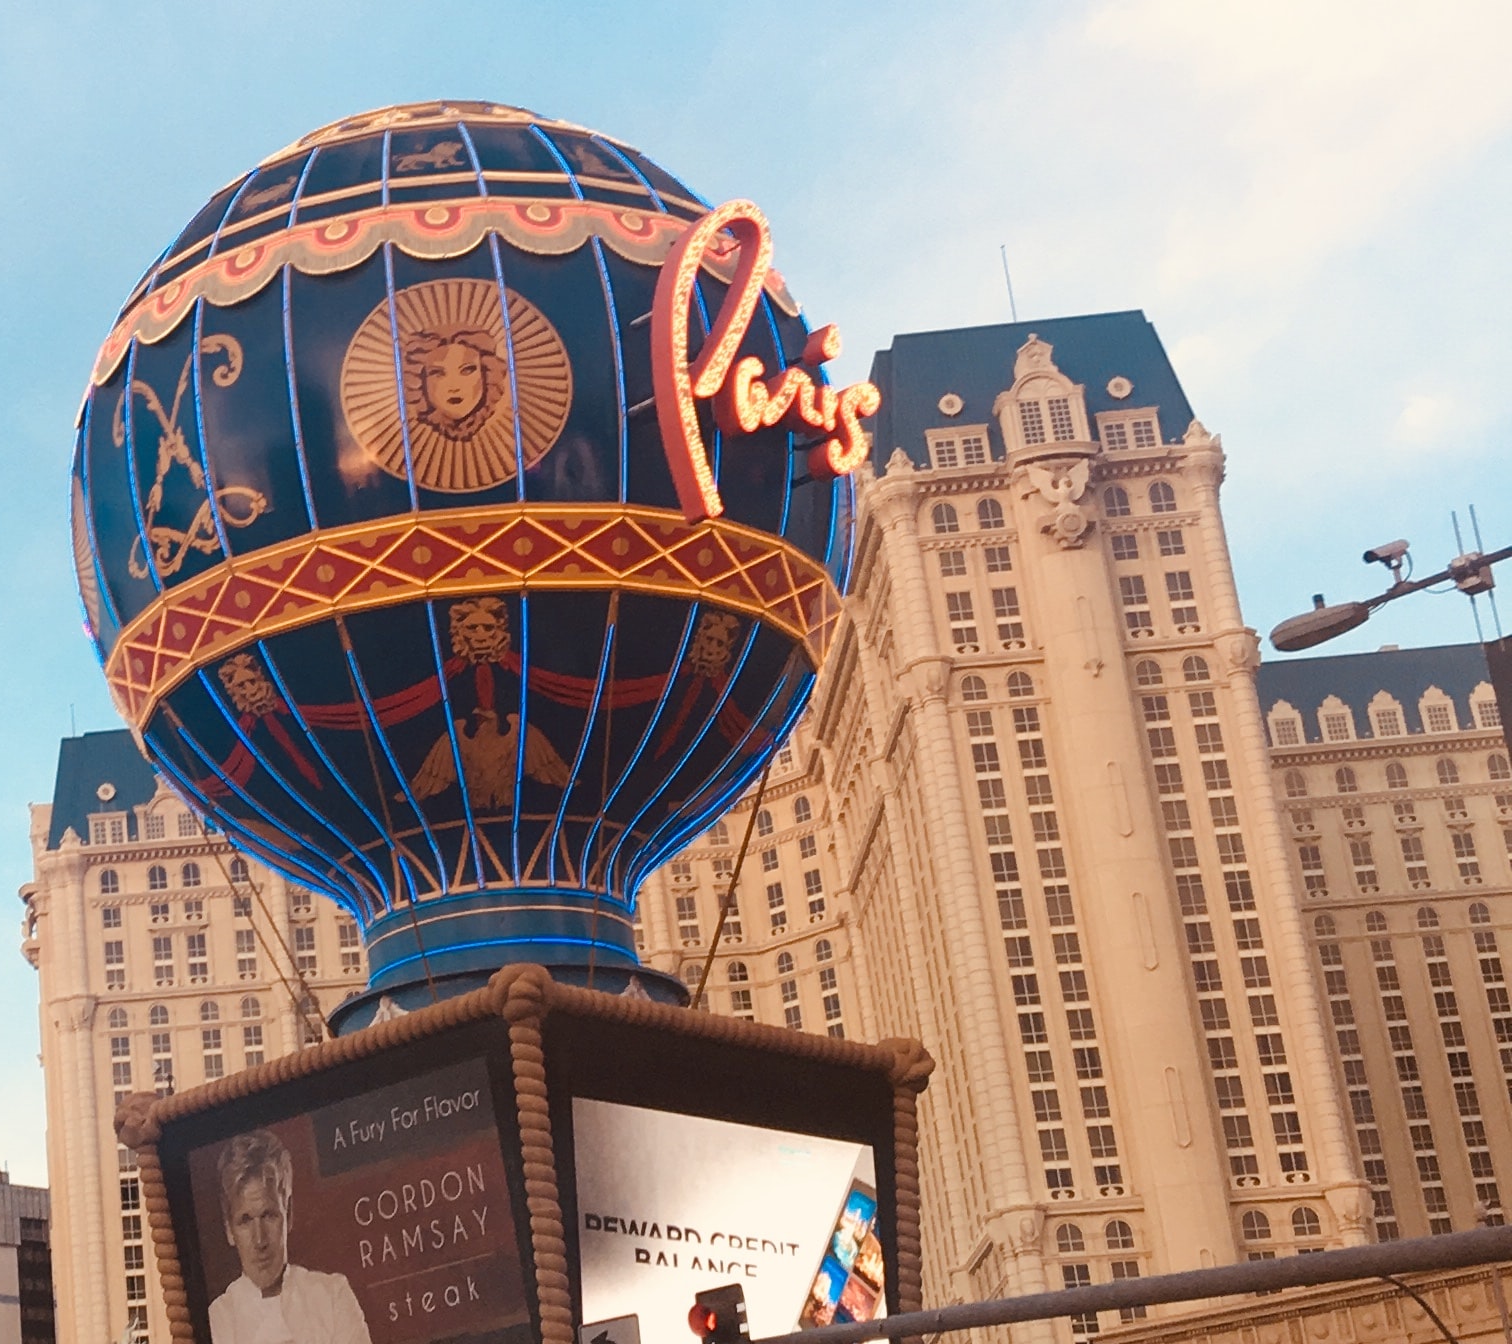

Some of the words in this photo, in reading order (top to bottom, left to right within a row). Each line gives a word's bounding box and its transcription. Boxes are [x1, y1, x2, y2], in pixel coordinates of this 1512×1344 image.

[652, 198, 882, 523] Paris
[333, 1128, 347, 1150] A
[350, 1120, 385, 1144] Fury
[391, 1107, 418, 1132] For
[424, 1089, 481, 1122] Flavor
[354, 1163, 485, 1226] GORDON
[359, 1206, 488, 1269] RAMSAY
[388, 1276, 480, 1322] steak
